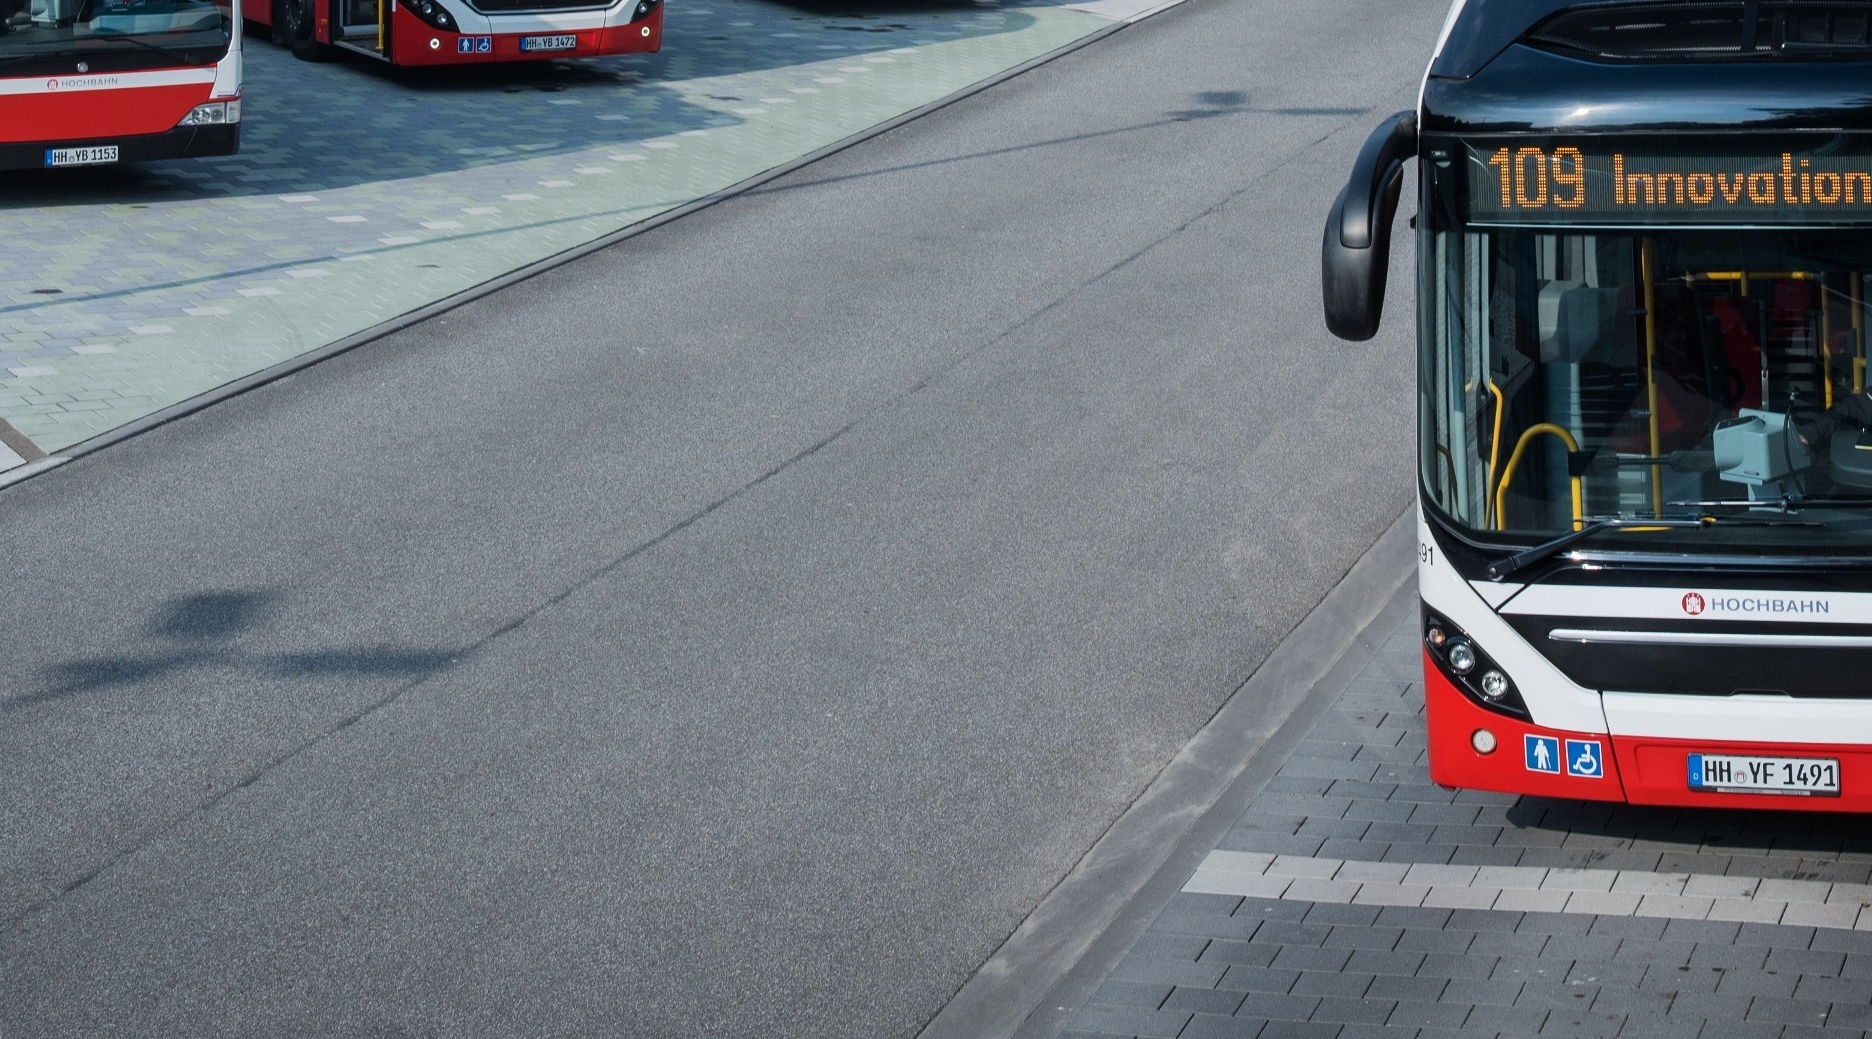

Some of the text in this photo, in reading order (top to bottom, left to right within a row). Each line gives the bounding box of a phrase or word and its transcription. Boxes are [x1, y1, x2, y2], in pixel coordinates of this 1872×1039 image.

[526, 35, 575, 49] HH YB 1472
[61, 77, 119, 88] HOCHBAHN
[53, 146, 118, 164] HH YB 1153
[1489, 147, 1585, 209] 109
[1712, 598, 1829, 613] HOCHBAHN
[1705, 760, 1732, 783] HH
[1749, 761, 1775, 784] YF
[1782, 763, 1836, 787] 1491
